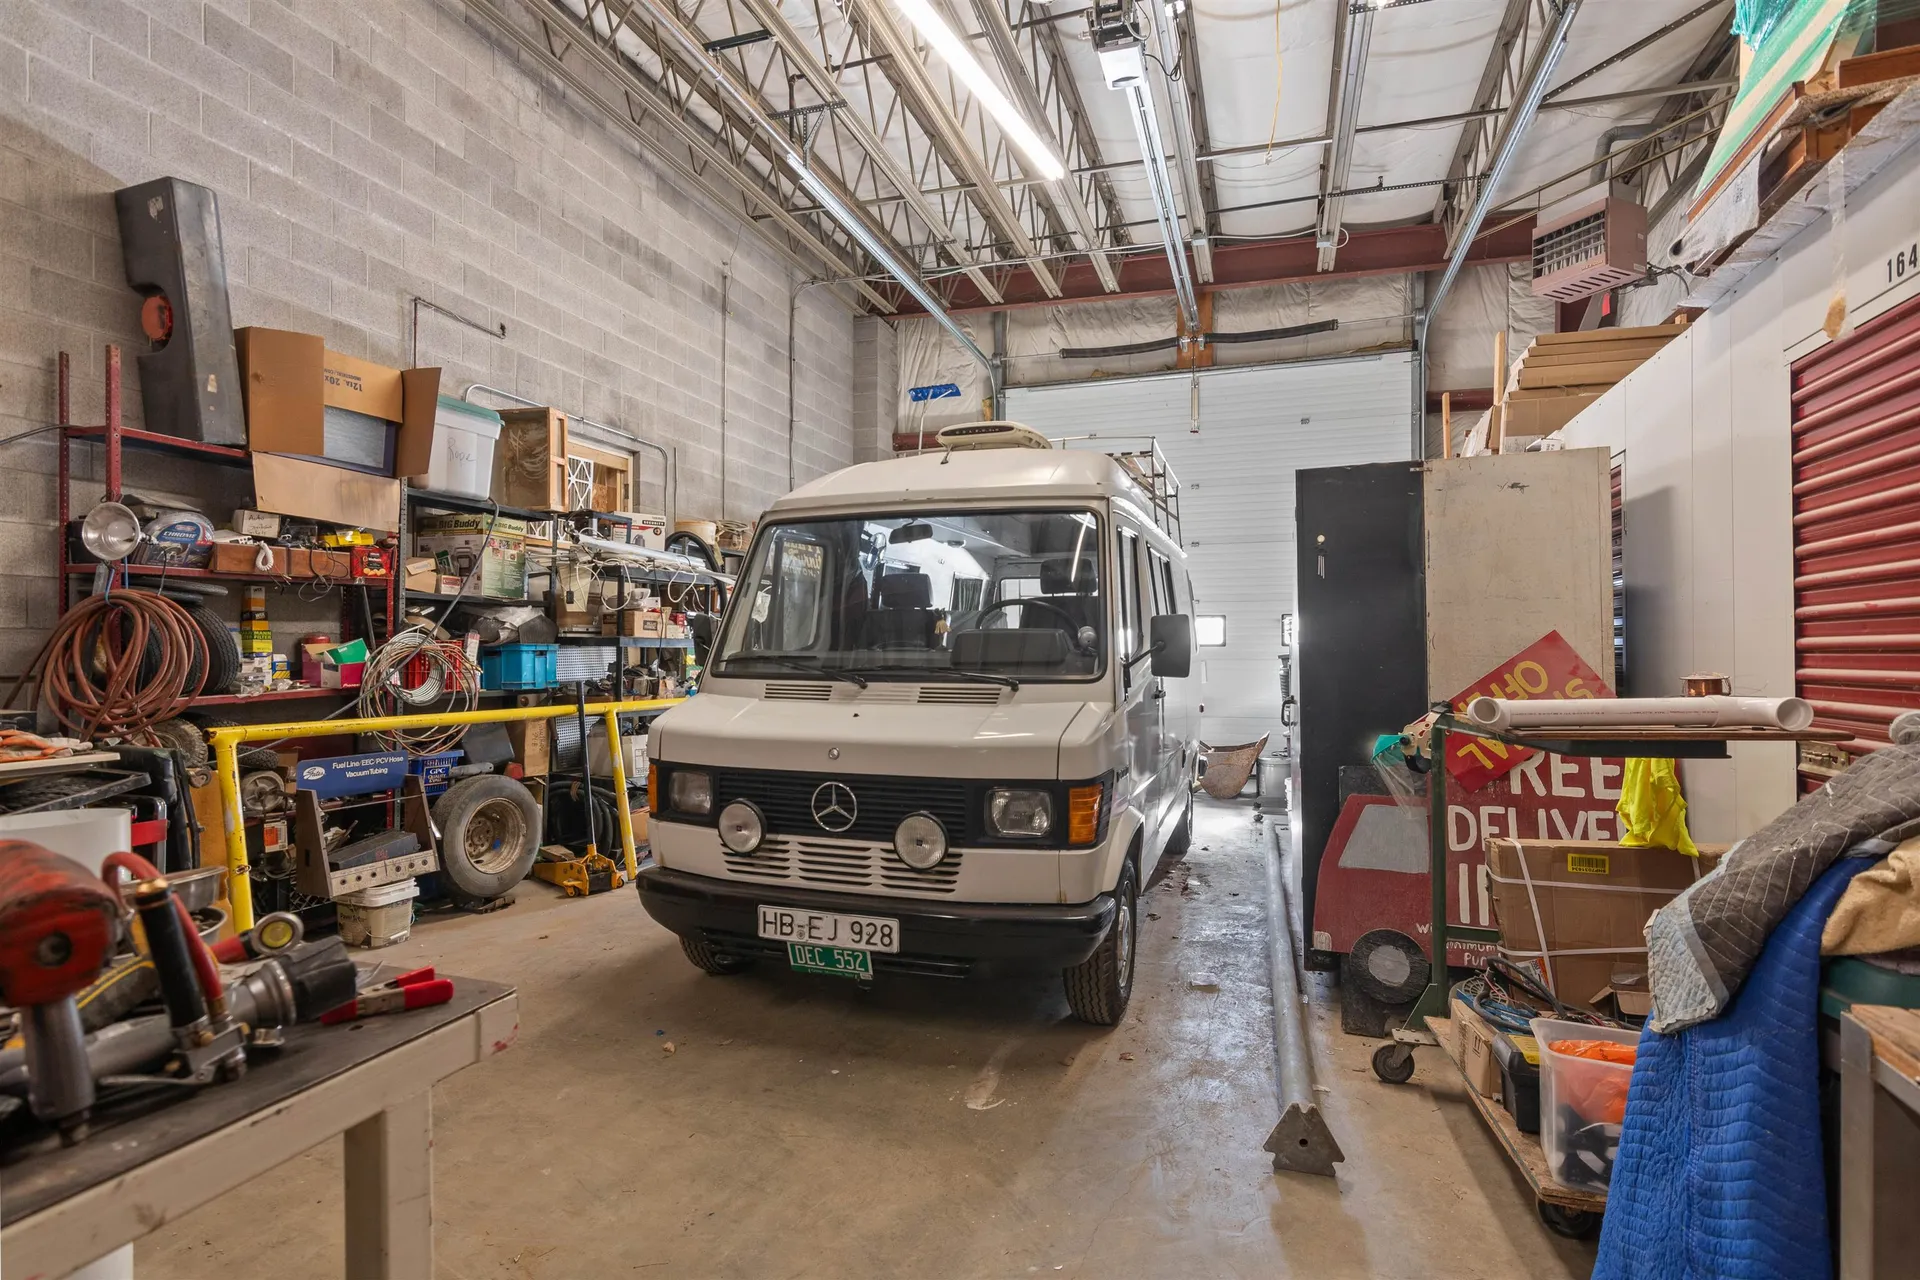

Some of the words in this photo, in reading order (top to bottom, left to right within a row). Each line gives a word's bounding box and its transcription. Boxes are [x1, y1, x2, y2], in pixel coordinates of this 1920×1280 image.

[1886, 243, 1918, 283] 164
[453, 519, 481, 530] Buddy
[507, 524, 524, 533] Buddy
[332, 761, 346, 770] Fuel
[429, 767, 446, 775] GPC
[345, 770, 370, 778] Vacuum
[369, 767, 388, 776] Tubing
[1510, 751, 1622, 800] REE
[850, 920, 894, 948] 928
[794, 945, 826, 966] DEC
[833, 949, 866, 971] 552
